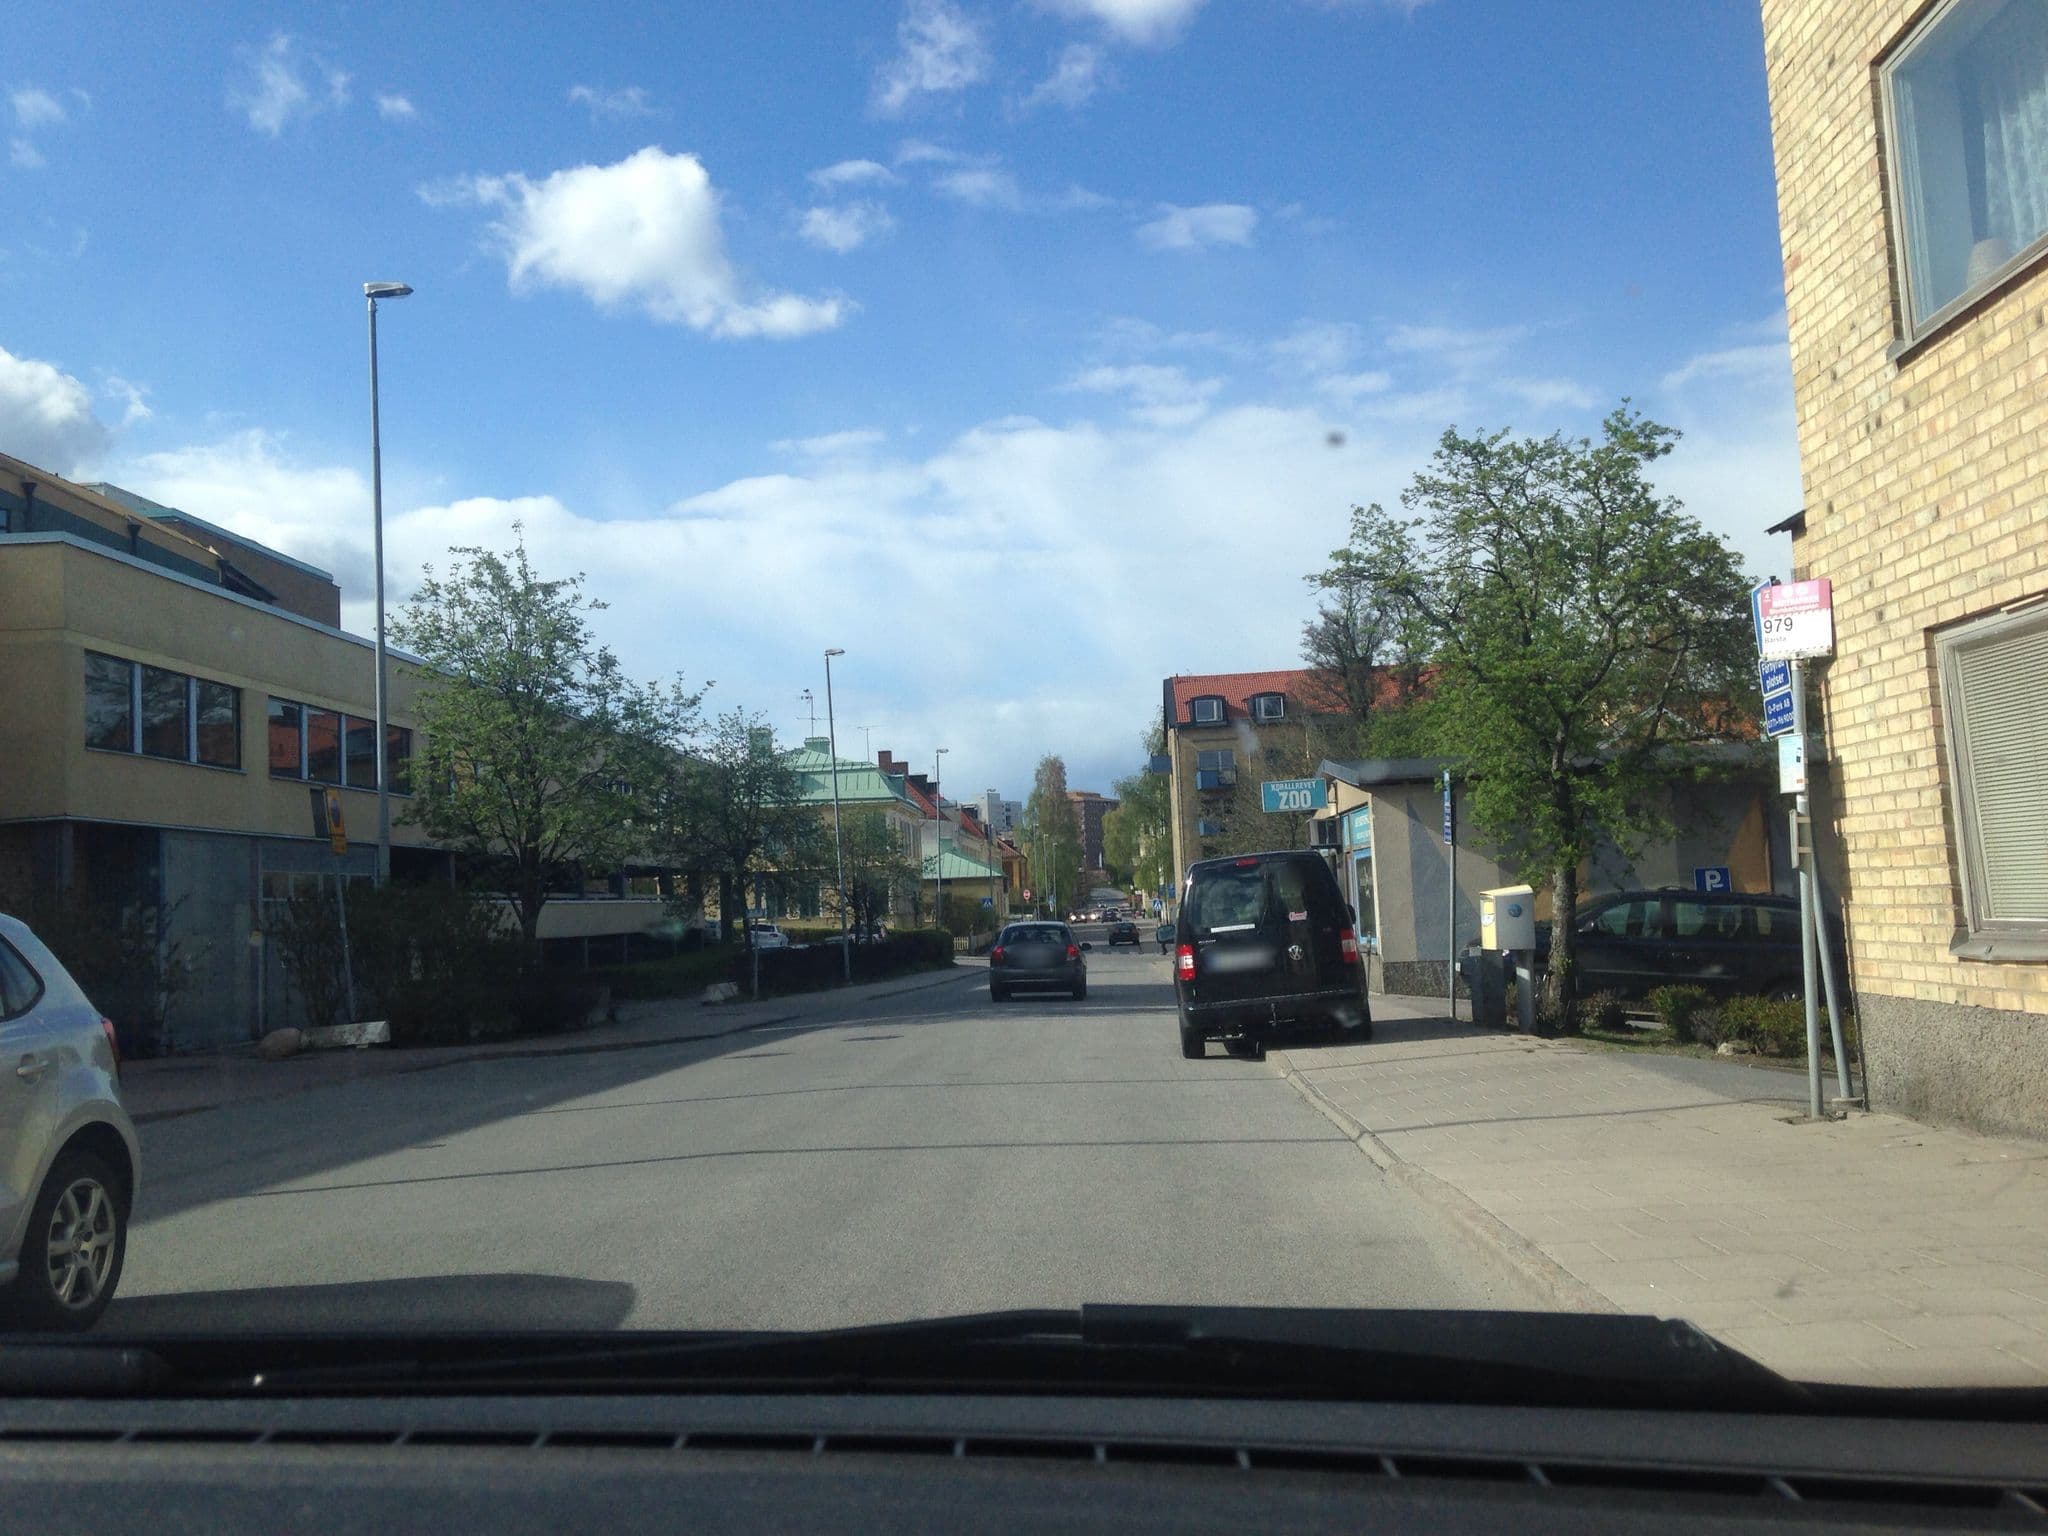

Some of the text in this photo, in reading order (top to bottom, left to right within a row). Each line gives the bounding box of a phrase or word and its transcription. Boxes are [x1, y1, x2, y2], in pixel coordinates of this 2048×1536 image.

[1763, 616, 1793, 634] 979
[1279, 790, 1312, 810] ZOO
[1705, 869, 1721, 892] P
